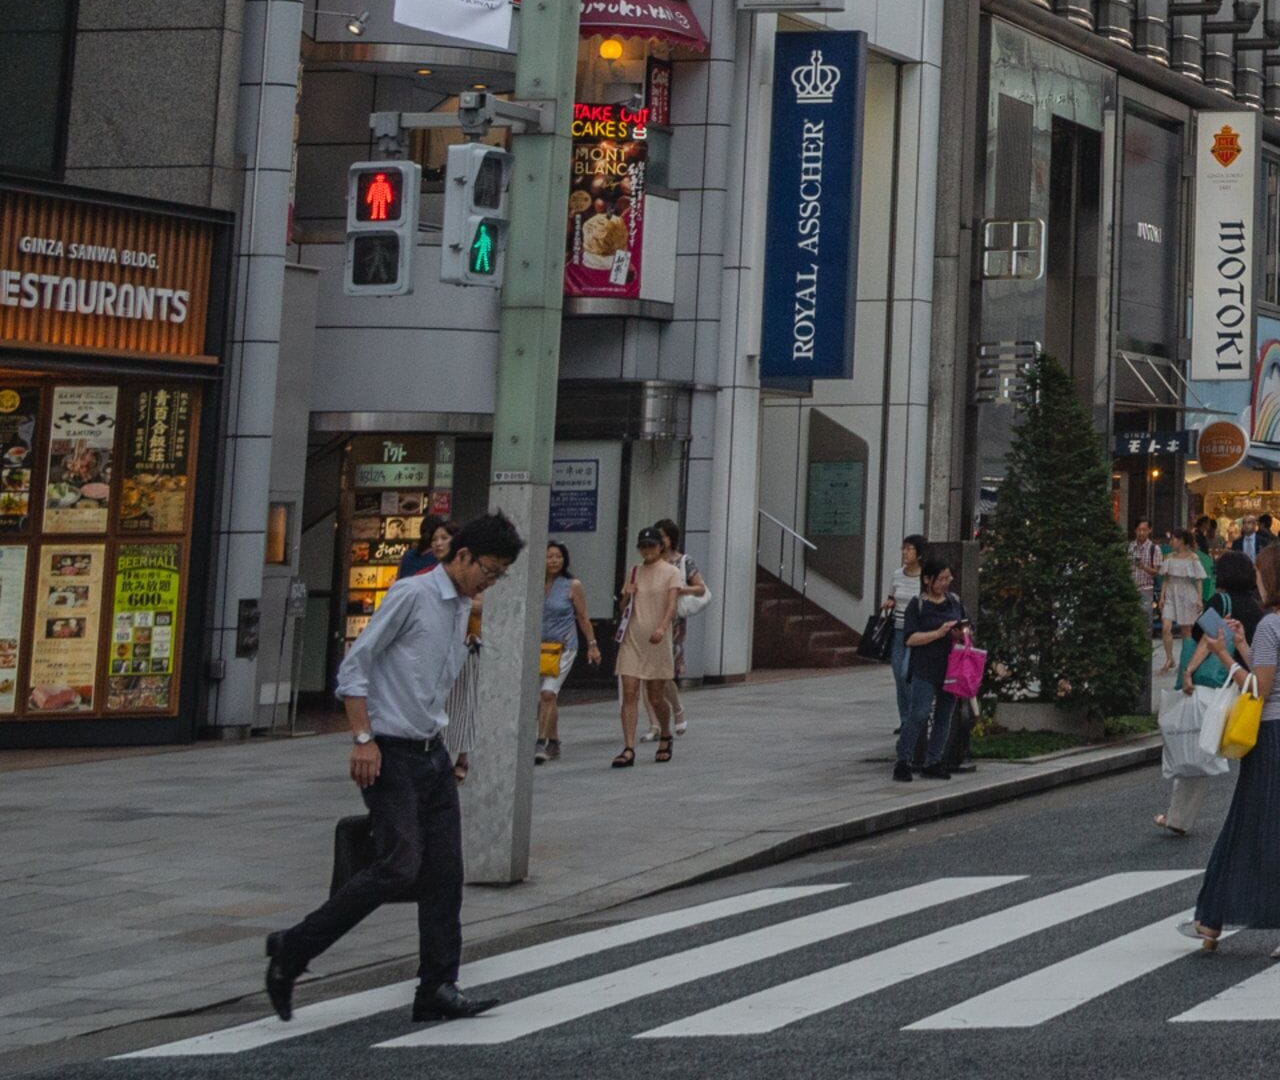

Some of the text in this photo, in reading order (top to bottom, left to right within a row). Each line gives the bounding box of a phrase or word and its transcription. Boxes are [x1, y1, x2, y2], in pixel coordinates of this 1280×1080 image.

[574, 103, 649, 123] TAKE OUT
[571, 121, 629, 138] CAKES
[576, 148, 627, 162] MONT
[575, 162, 630, 176] BLANC
[793, 118, 826, 361] ROYAL ASSCHER
[20, 236, 160, 269] GINZA SANWA BLDG.
[1126, 438, 1181, 454] モトキ
